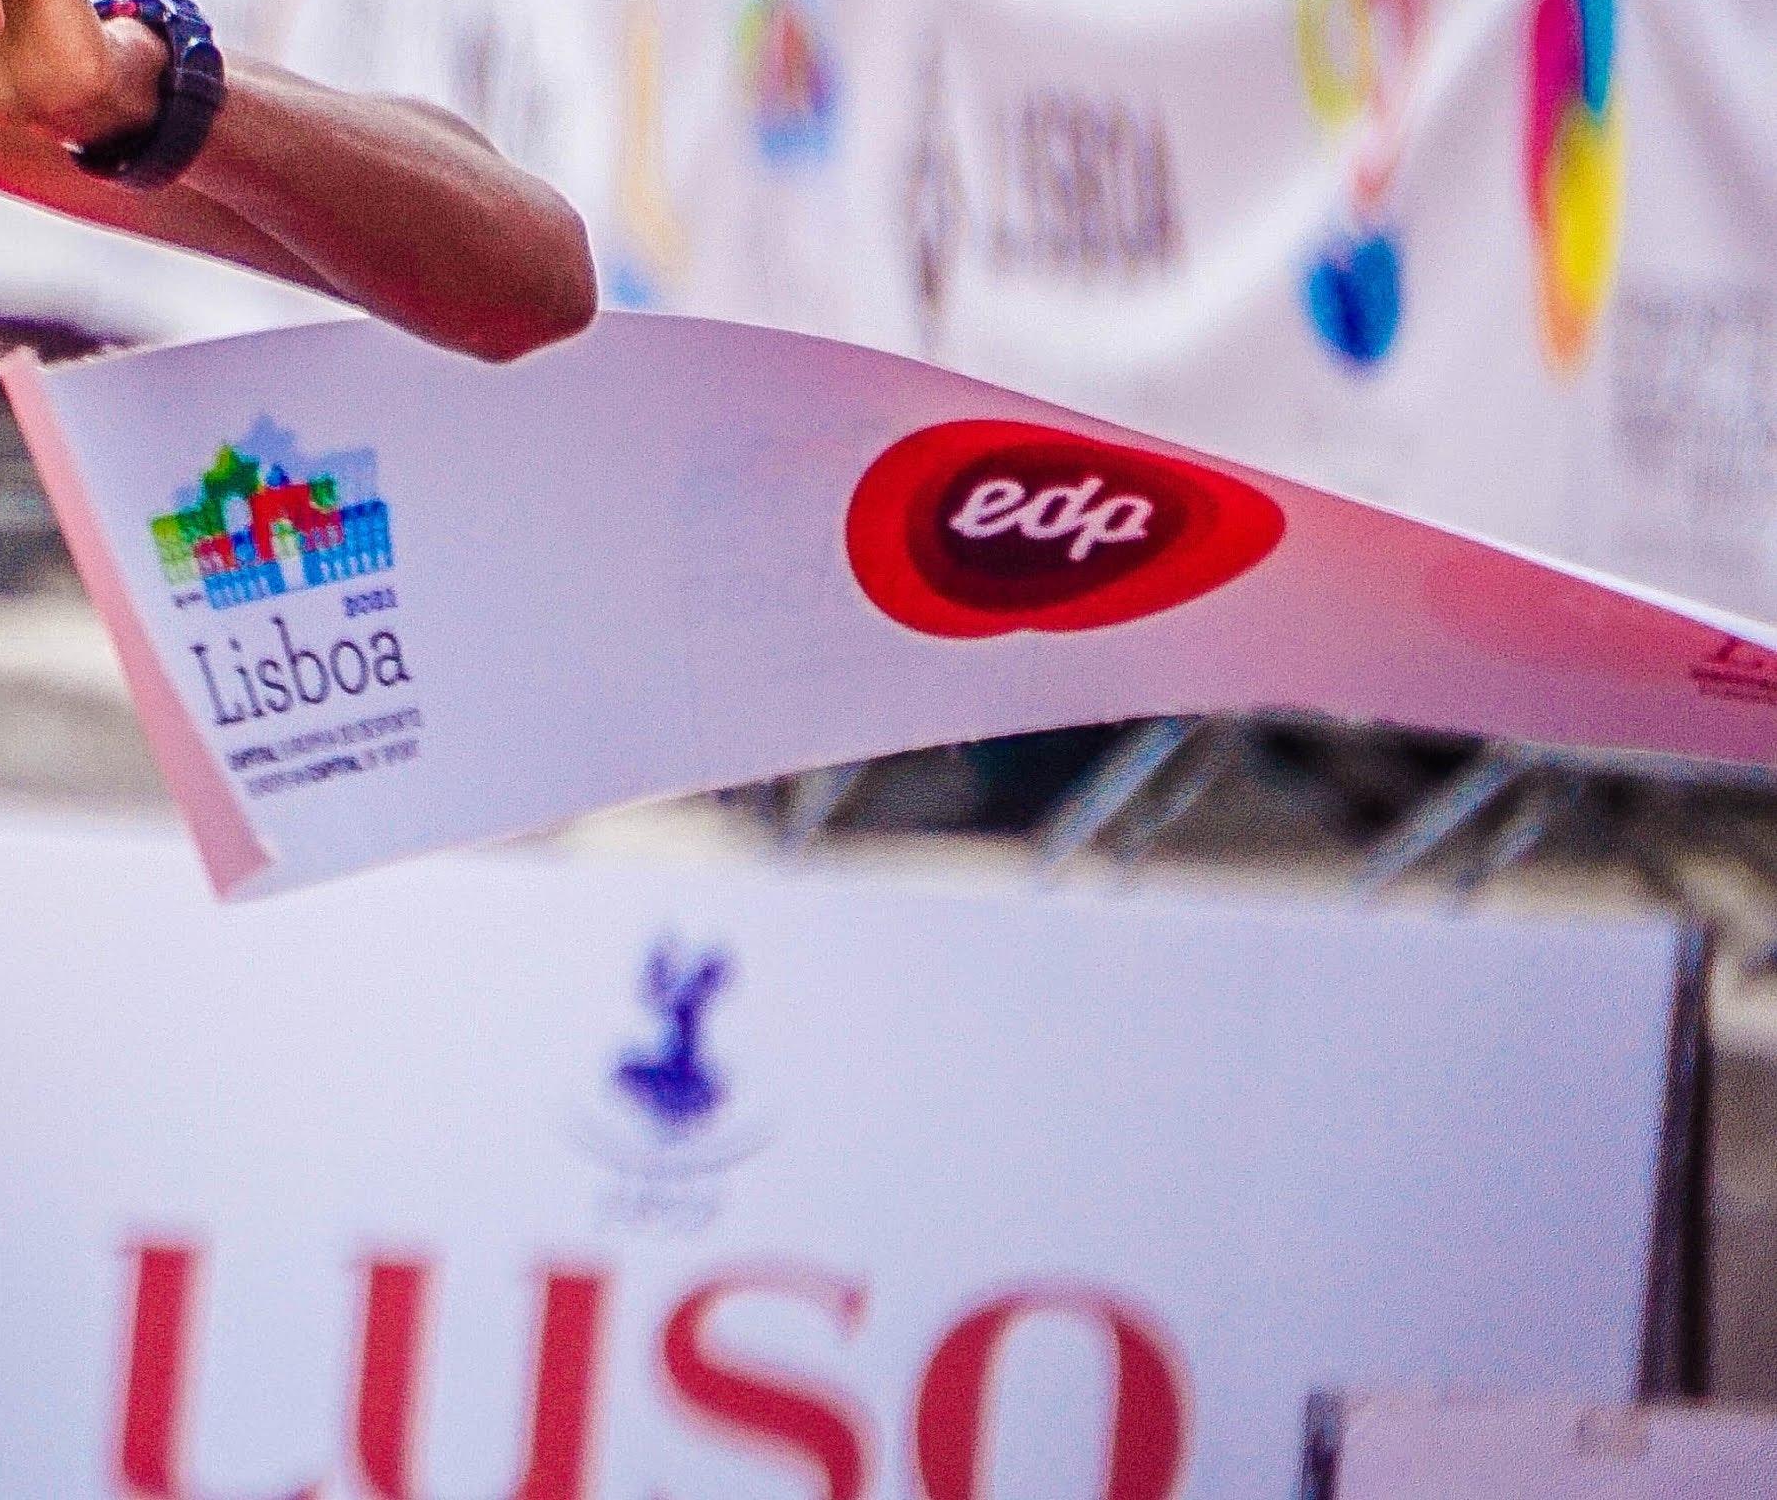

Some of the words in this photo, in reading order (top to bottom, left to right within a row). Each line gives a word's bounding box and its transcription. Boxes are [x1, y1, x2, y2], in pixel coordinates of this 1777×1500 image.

[949, 475, 1154, 562] edp
[189, 614, 413, 726] Lisboa
[110, 1235, 1190, 1500] LUSO
